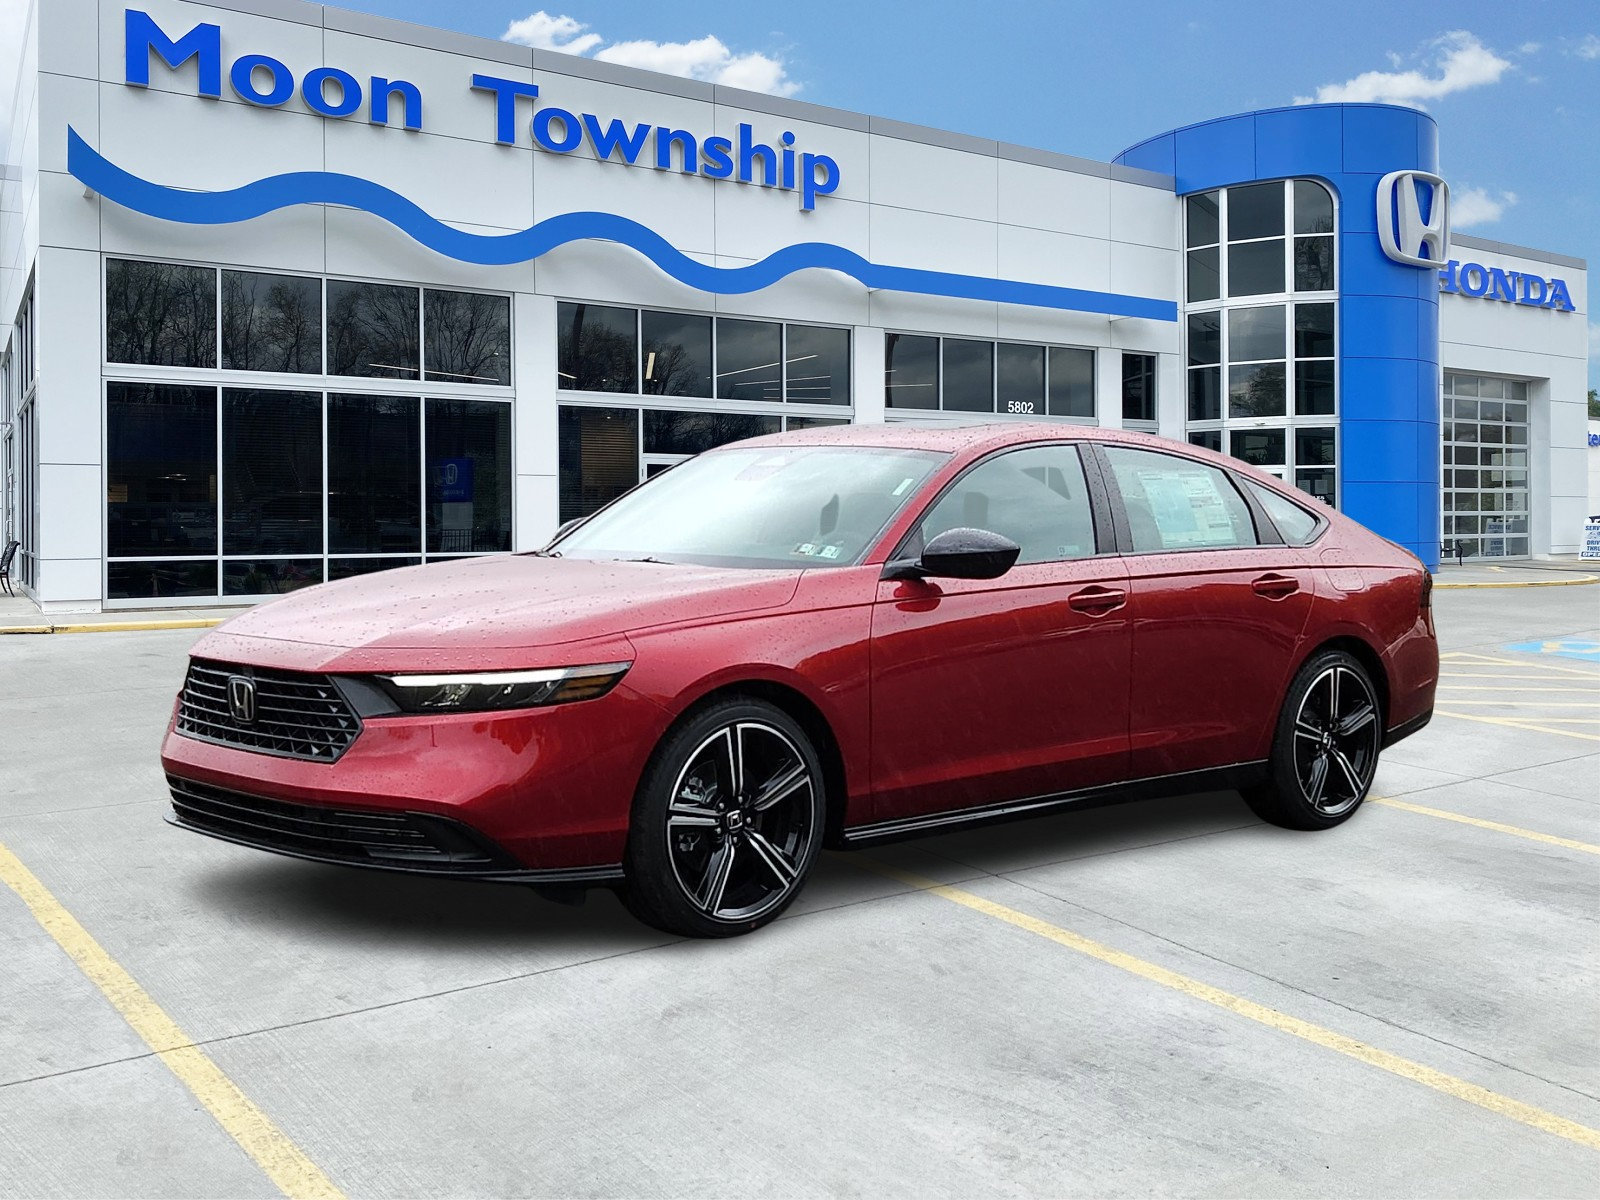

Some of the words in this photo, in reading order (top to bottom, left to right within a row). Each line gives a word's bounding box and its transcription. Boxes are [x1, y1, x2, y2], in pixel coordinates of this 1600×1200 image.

[125, 8, 422, 131] Moon
[470, 73, 840, 211] Township
[1007, 400, 1034, 414] 5802
